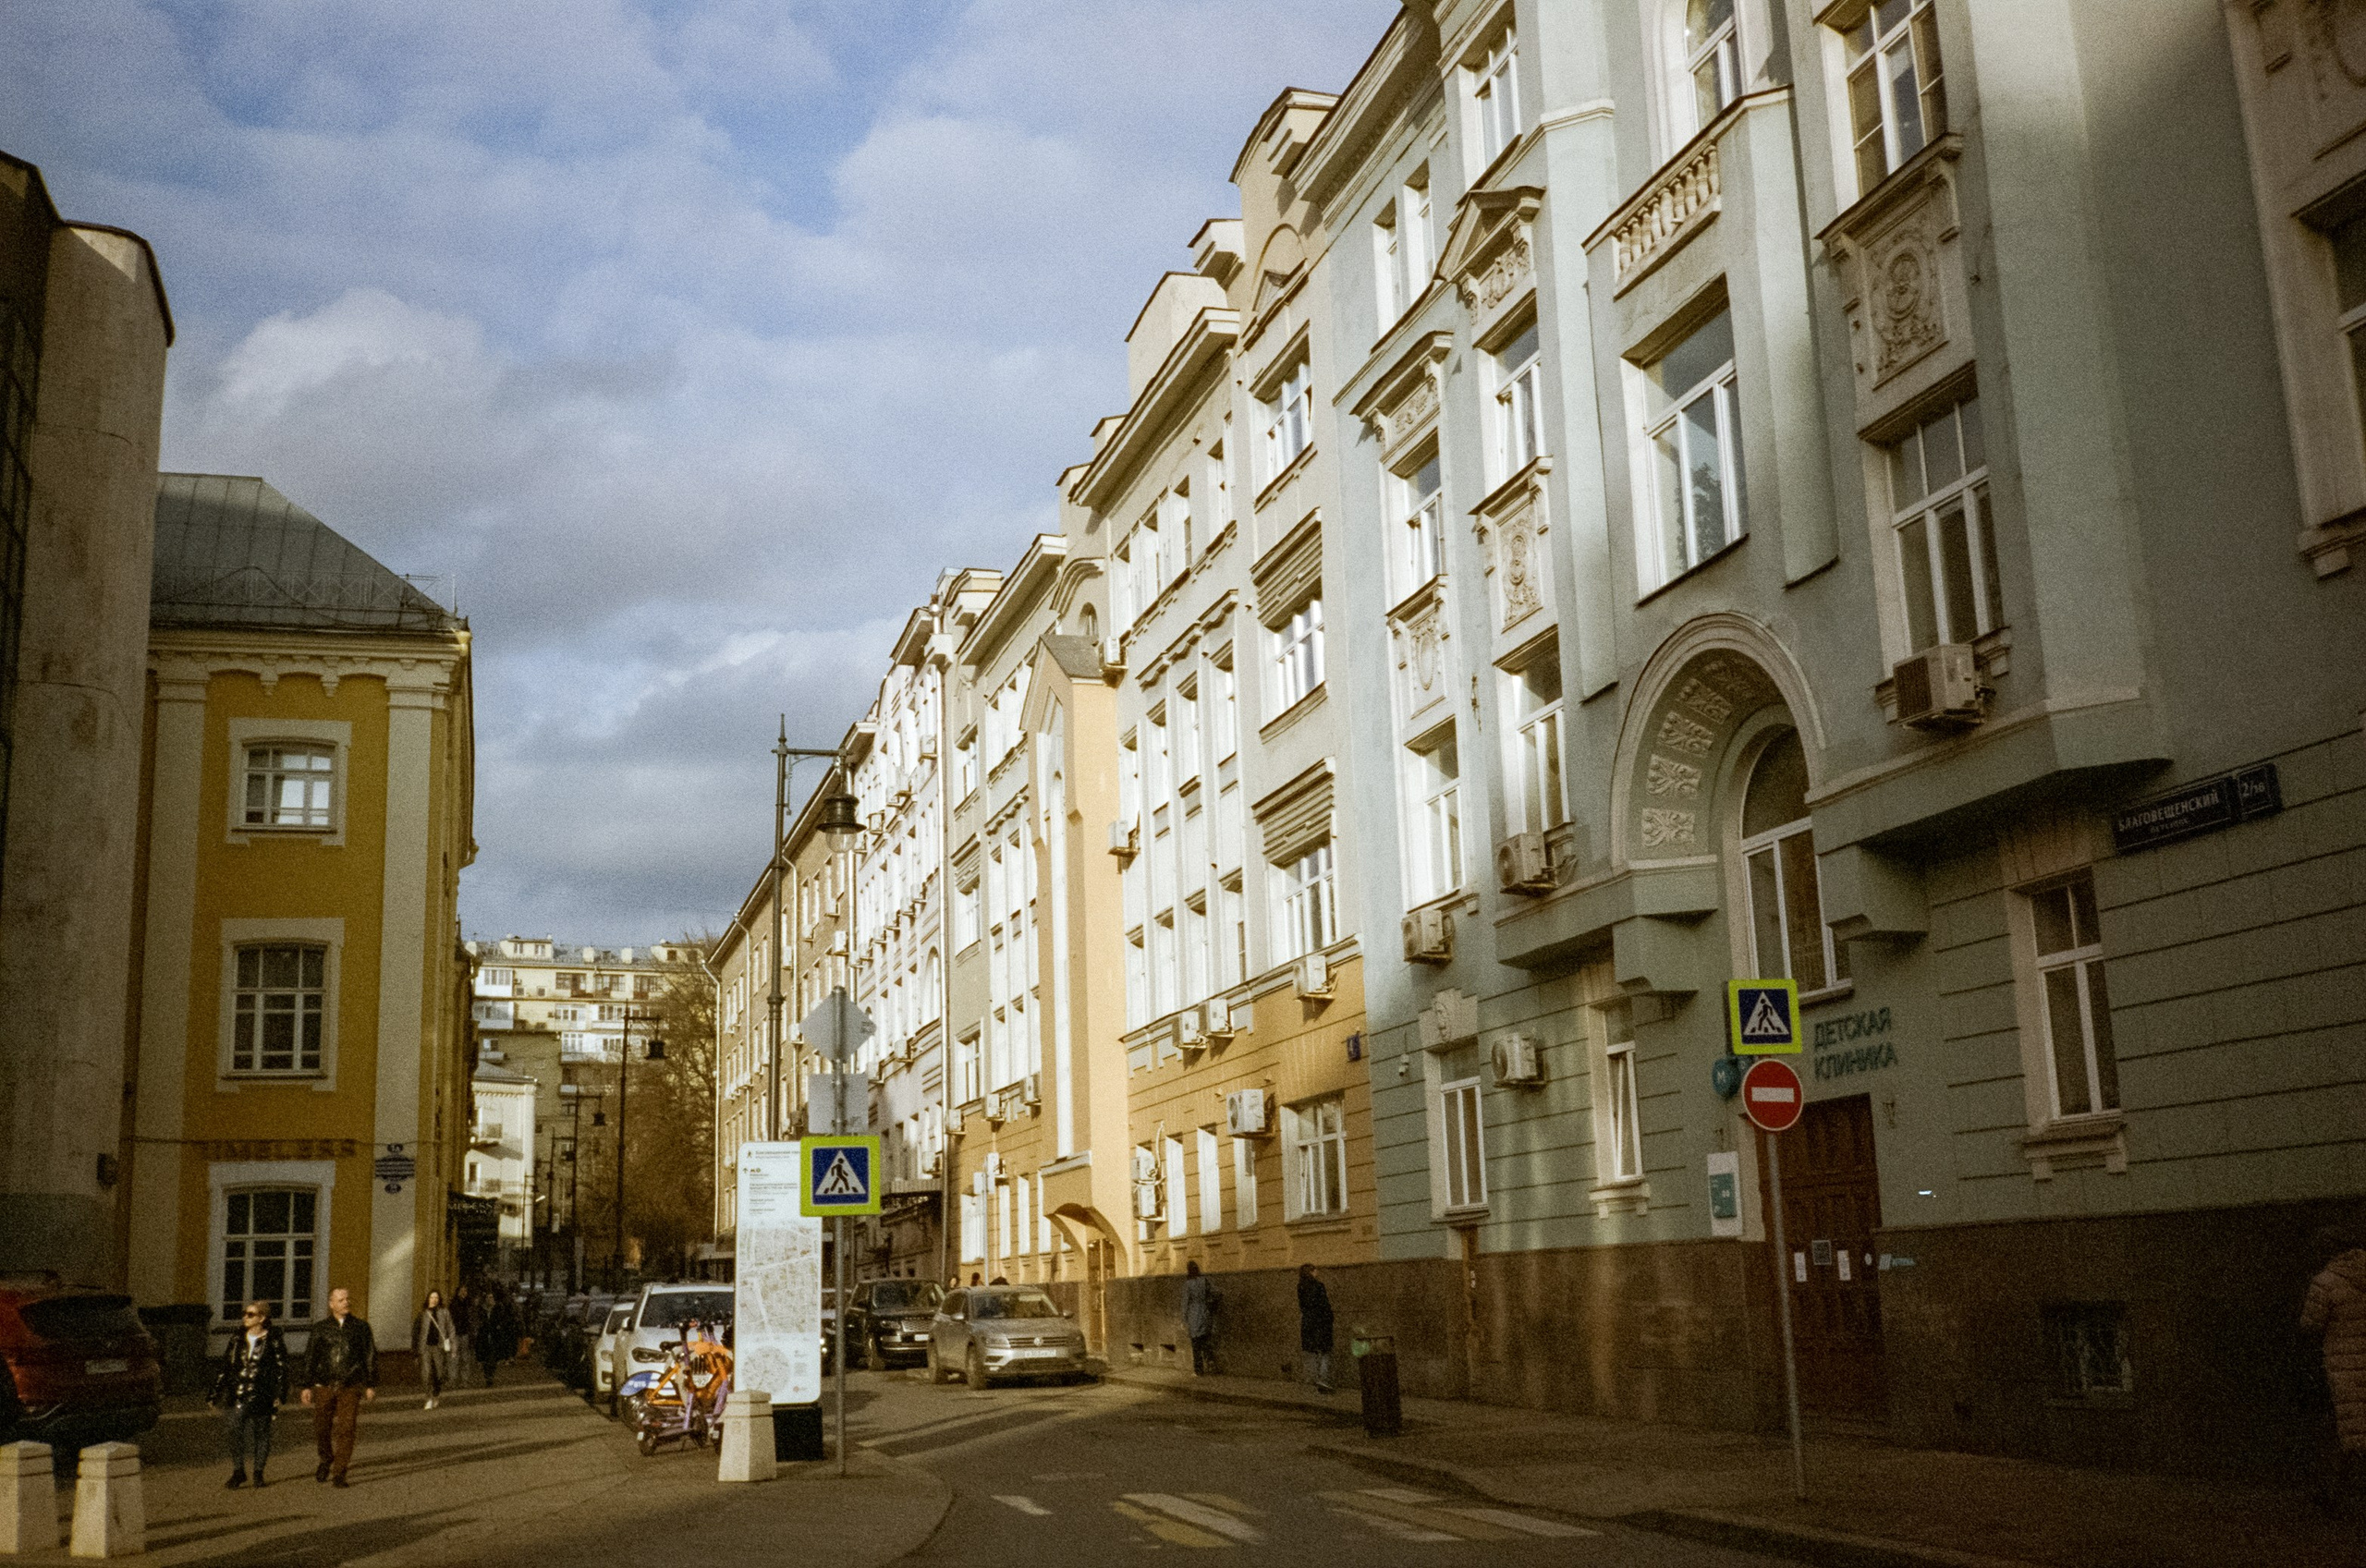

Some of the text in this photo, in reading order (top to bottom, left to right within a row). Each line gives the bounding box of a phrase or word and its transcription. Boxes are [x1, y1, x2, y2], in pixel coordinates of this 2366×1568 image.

[2117, 790, 2220, 832] БЛАГОВЕЩЕНСКИЙ
[1813, 1006, 1893, 1052] ДЕТСКАЯ
[1814, 1042, 1899, 1082] КЛИНИКА
